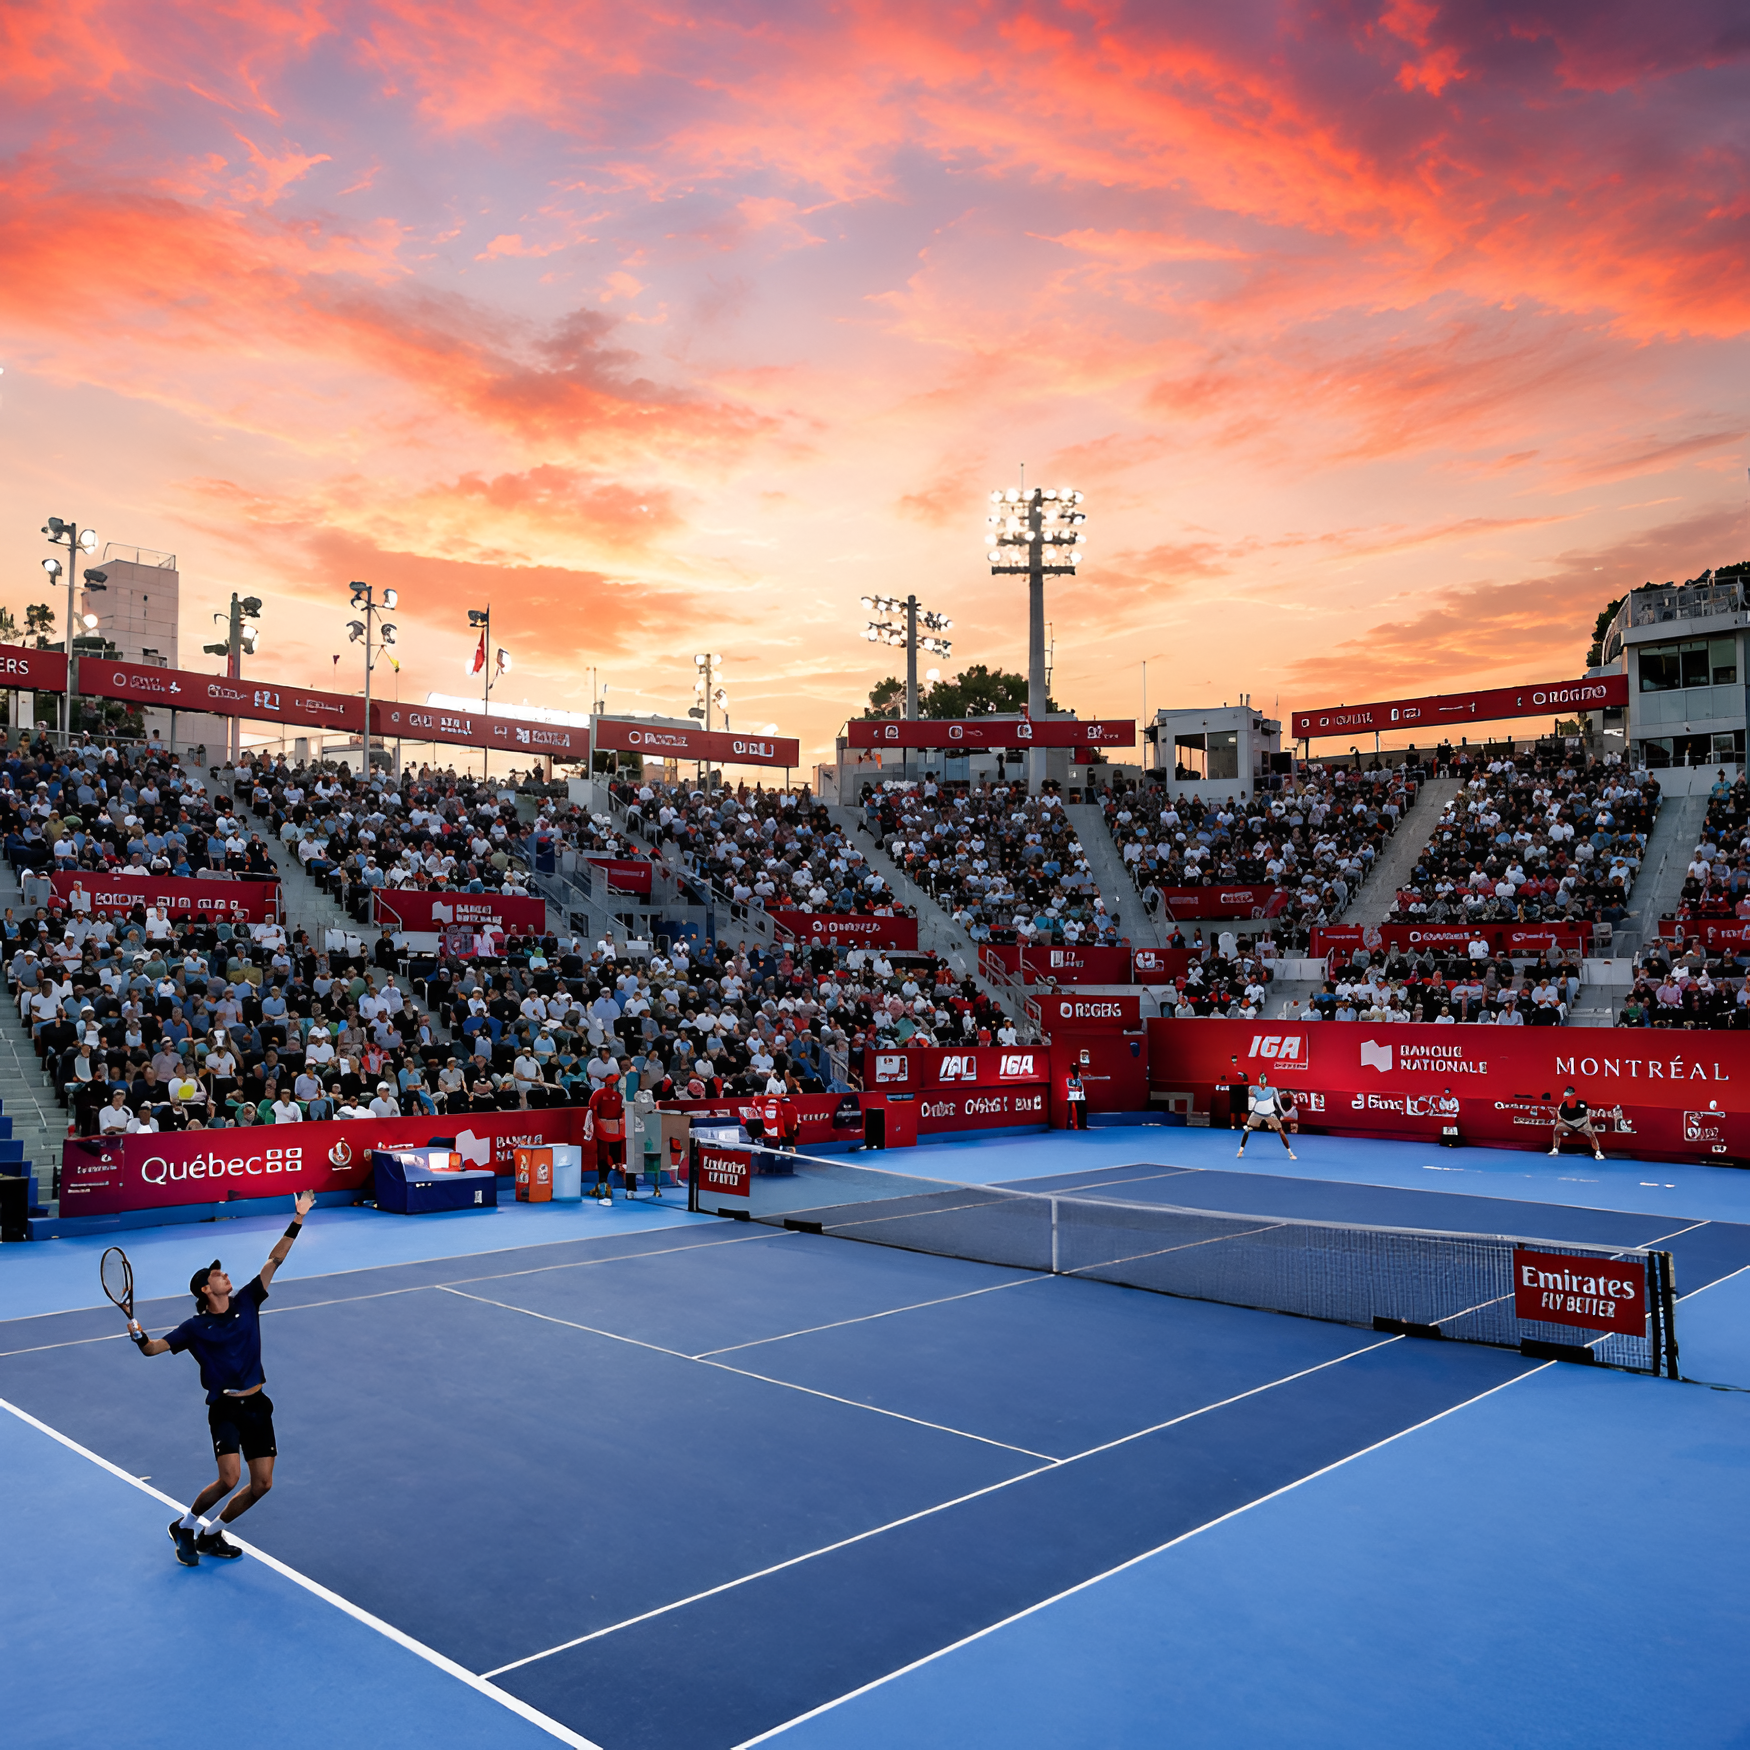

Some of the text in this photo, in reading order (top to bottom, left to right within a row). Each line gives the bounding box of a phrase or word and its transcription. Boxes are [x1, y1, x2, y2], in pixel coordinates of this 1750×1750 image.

[1248, 1035, 1301, 1059] IGA
[1000, 1054, 1034, 1076] IGA
[1400, 1059, 1488, 1075] NATIONALE
[1556, 1055, 1729, 1080] MONTRÉAL
[141, 1152, 263, 1185] Québec
[1521, 1265, 1636, 1299] Emirates
[1541, 1291, 1564, 1310] FLY
